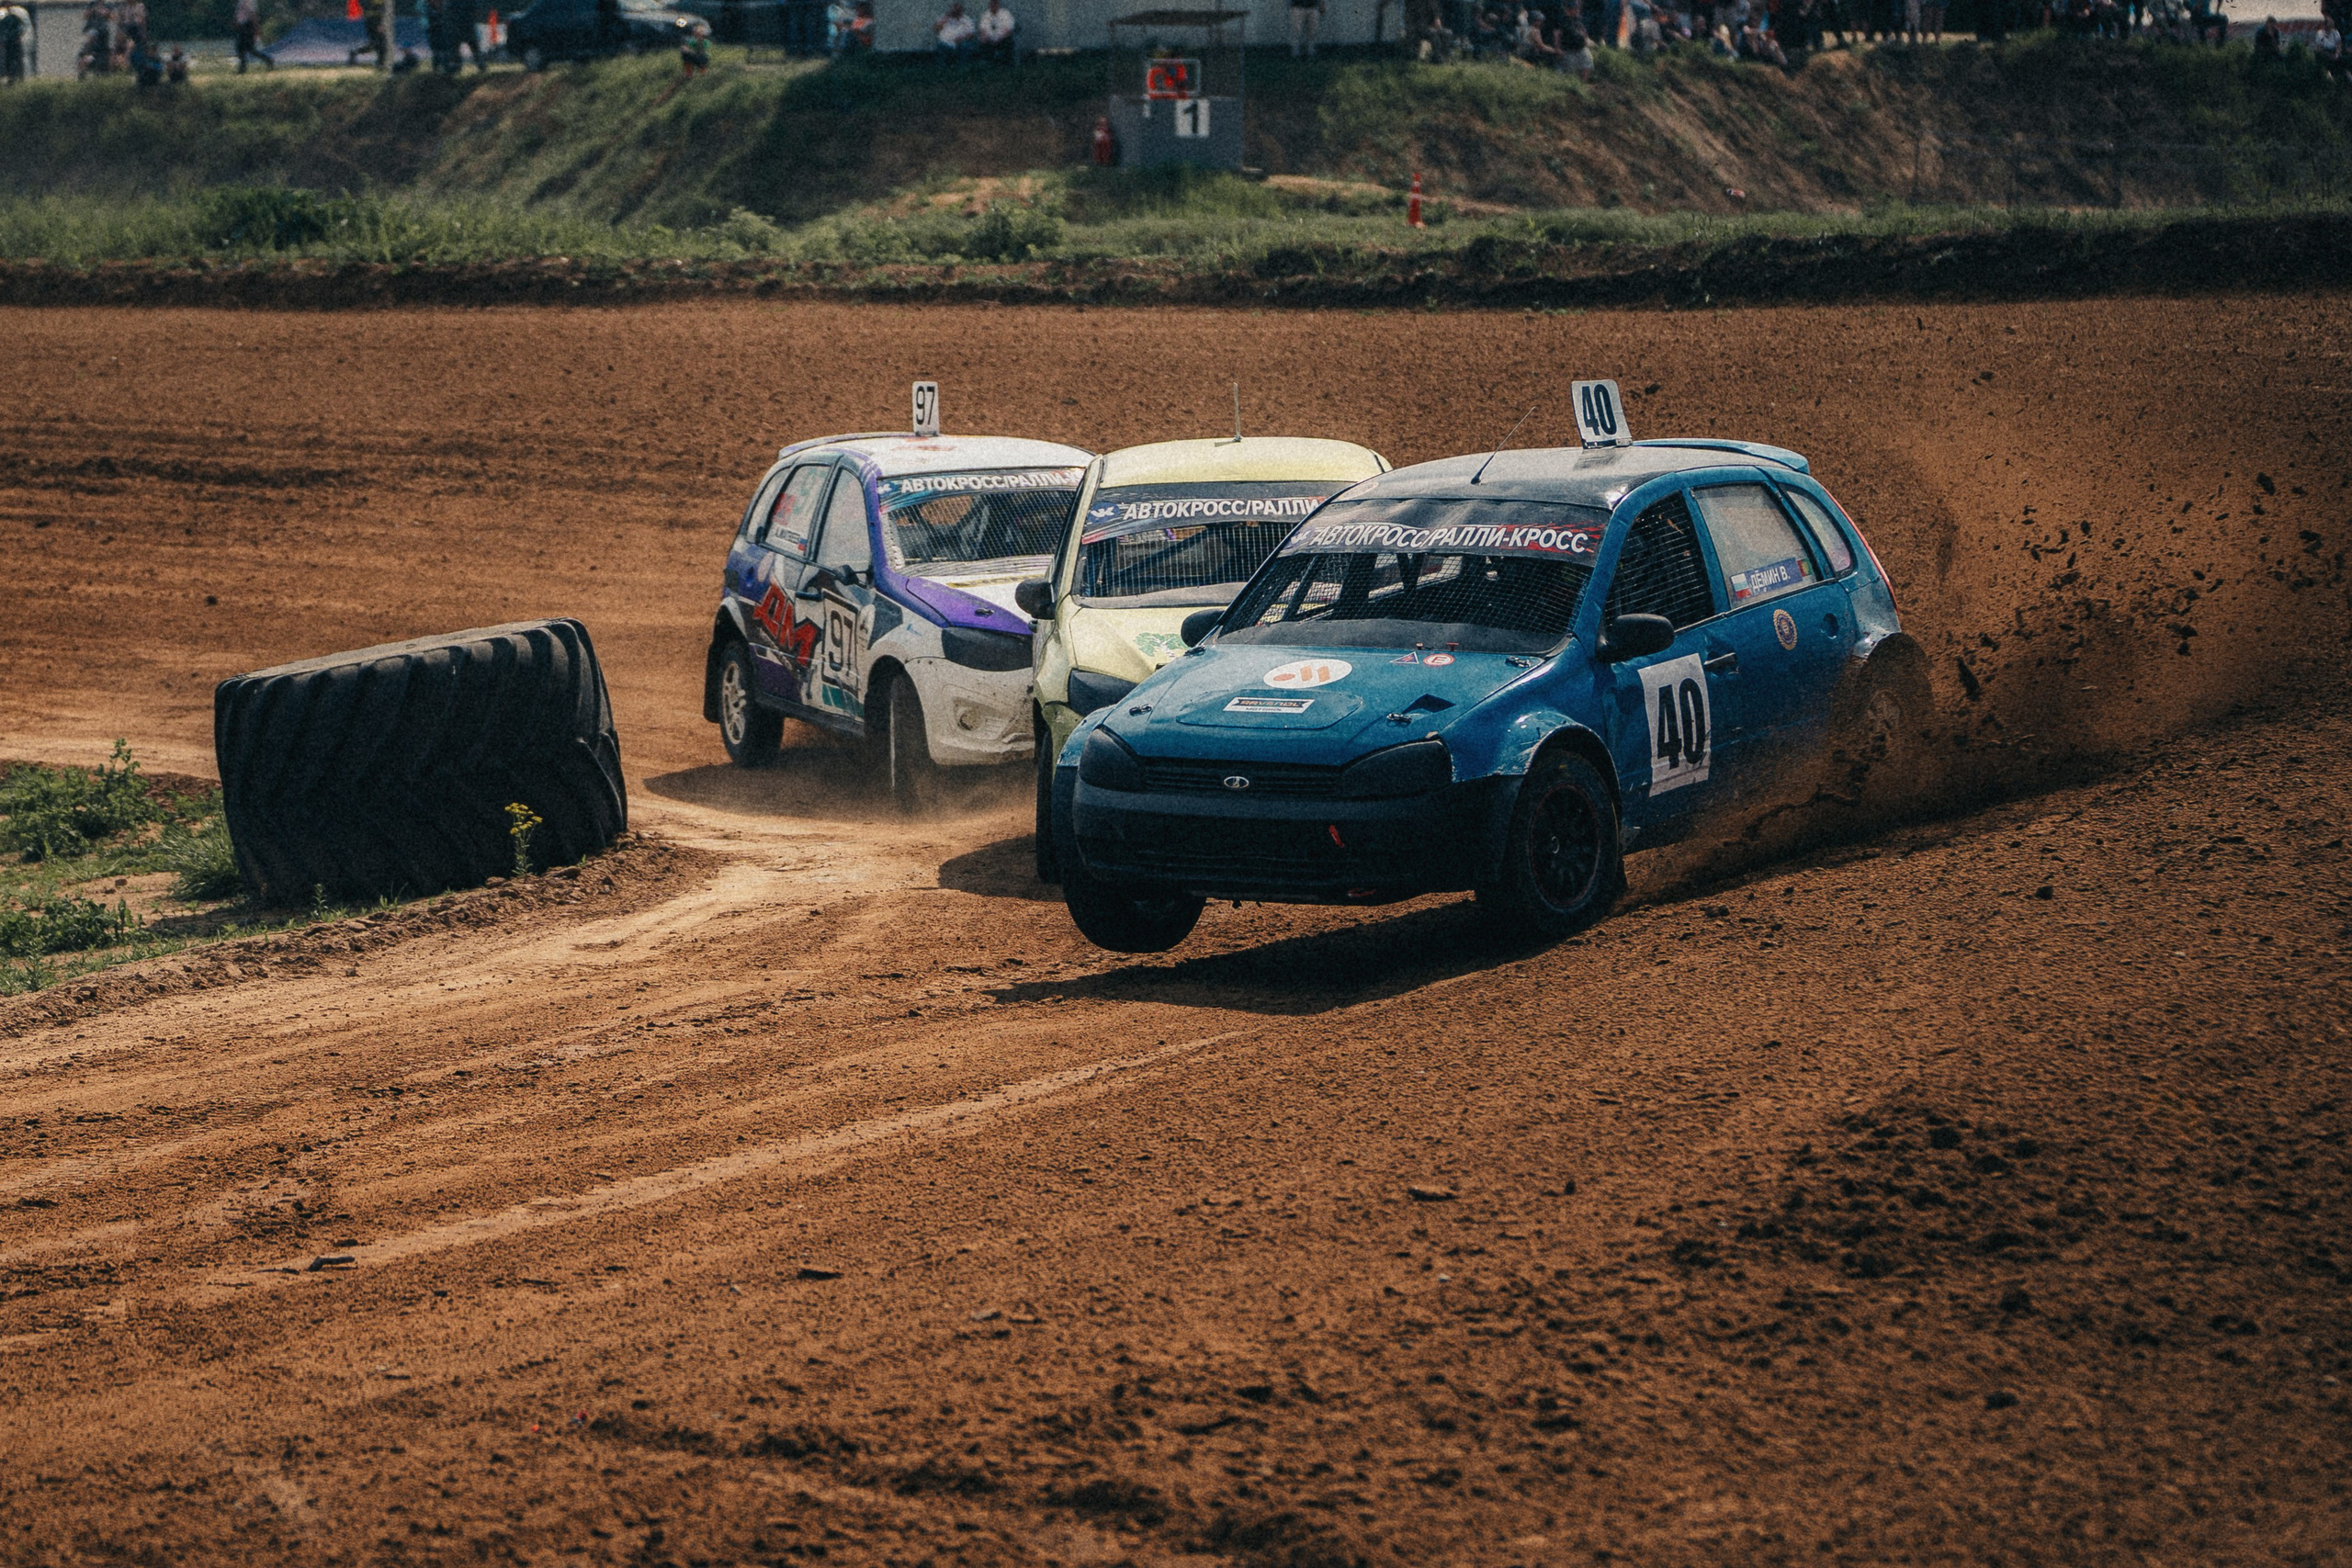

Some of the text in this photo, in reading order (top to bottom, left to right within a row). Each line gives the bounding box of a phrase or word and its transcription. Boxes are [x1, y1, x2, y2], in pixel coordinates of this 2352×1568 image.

[1183, 102, 1198, 135] 1
[916, 386, 935, 425] 97
[1582, 384, 1617, 436] 40
[828, 609, 854, 678] 97
[1430, 656, 1448, 664] E
[1657, 677, 1706, 771] 40
